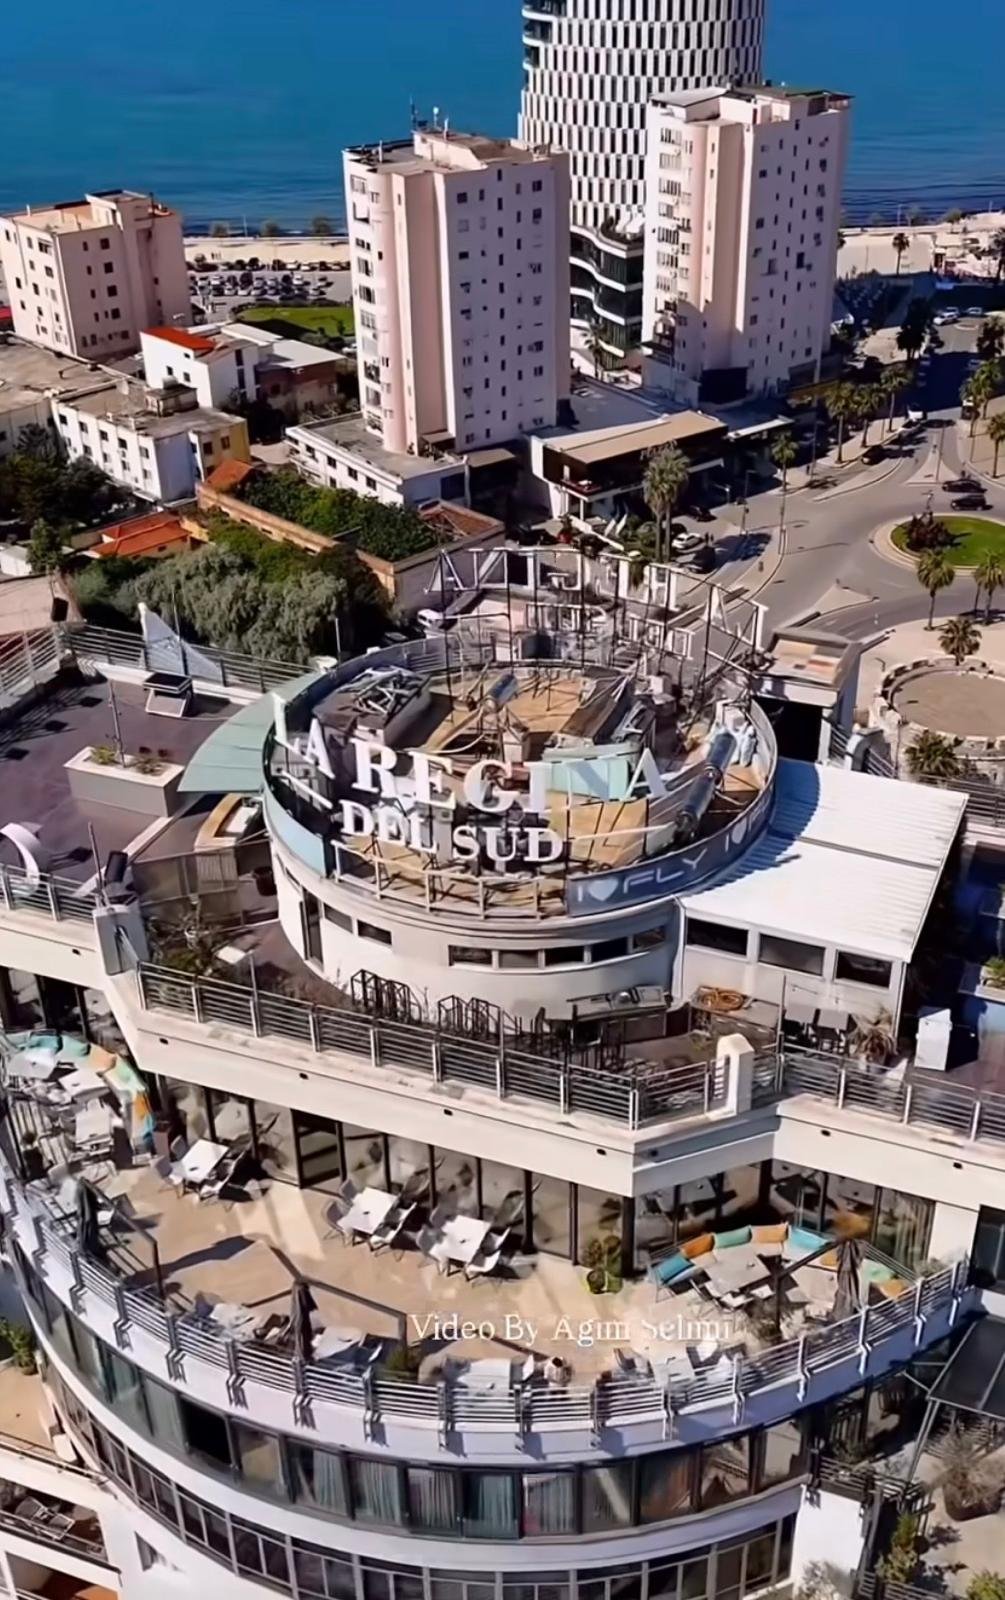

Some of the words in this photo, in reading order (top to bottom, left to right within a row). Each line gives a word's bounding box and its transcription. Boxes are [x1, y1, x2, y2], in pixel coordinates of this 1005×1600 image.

[338, 799, 440, 854] DEL
[452, 825, 563, 863] SUD
[624, 849, 707, 893] FLY
